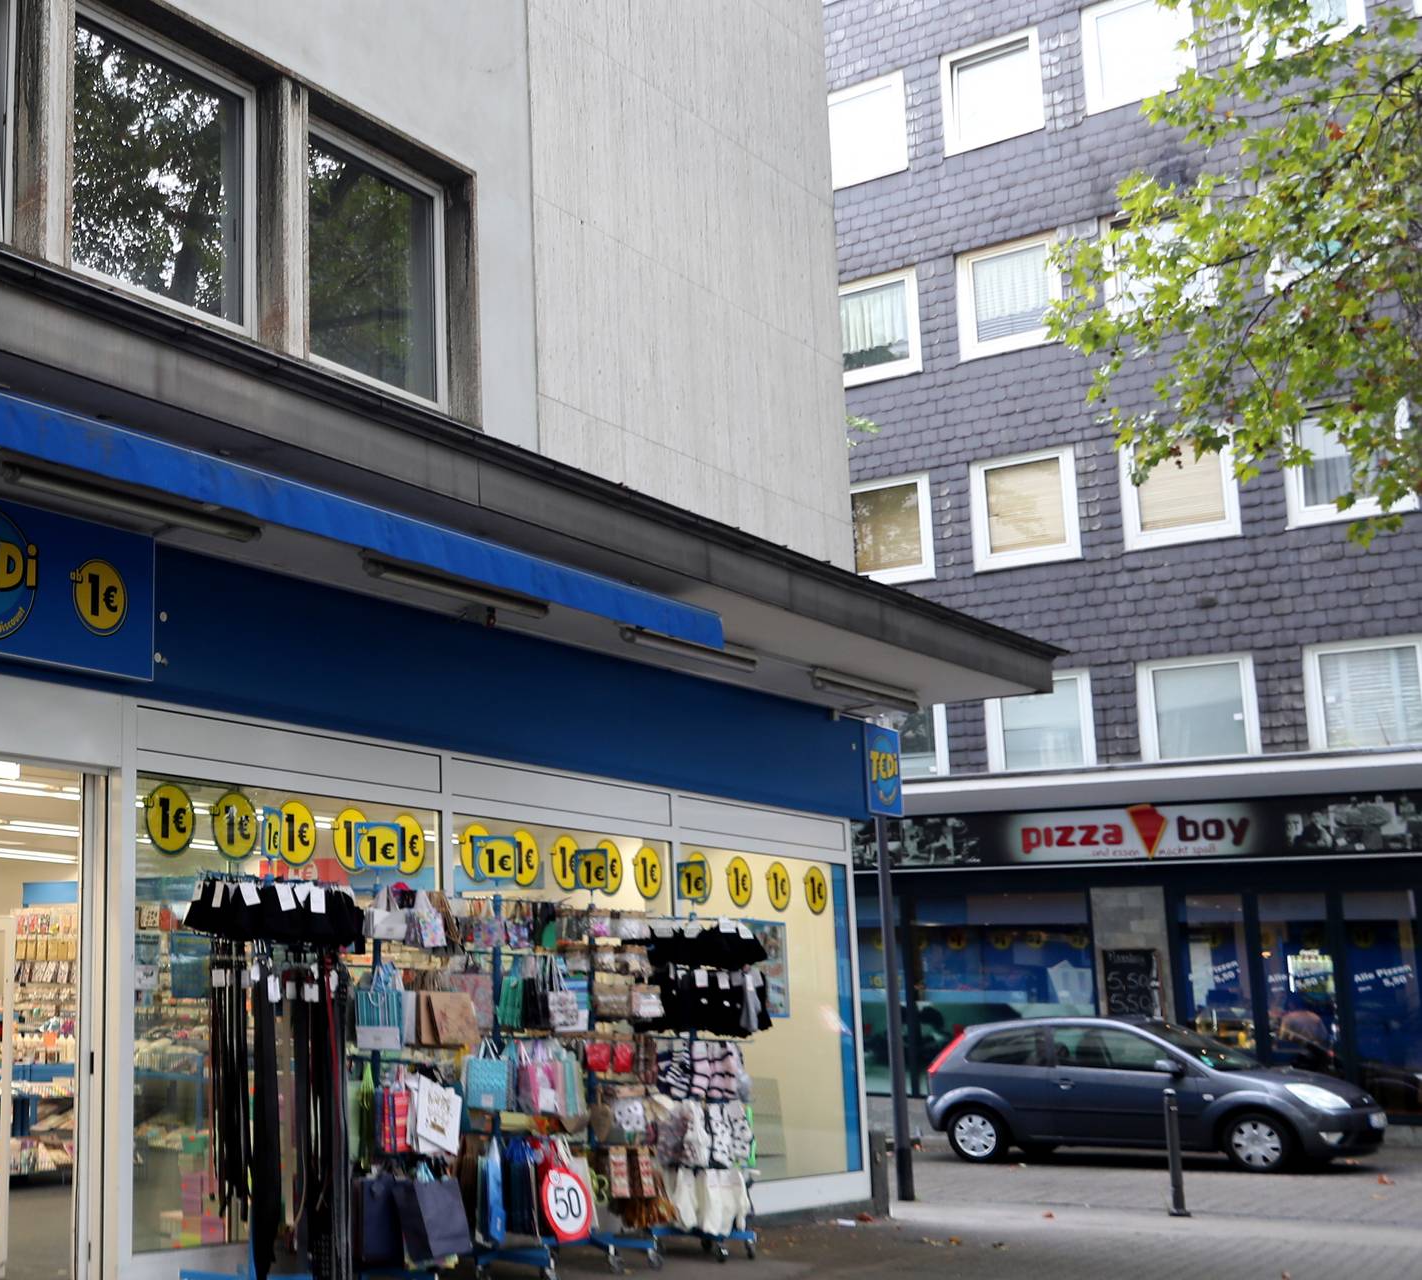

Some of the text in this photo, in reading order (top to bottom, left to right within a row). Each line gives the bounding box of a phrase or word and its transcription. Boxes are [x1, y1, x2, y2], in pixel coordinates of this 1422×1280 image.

[89, 573, 118, 617] 1€
[159, 797, 187, 839] 1€
[225, 805, 251, 846] 1€
[285, 813, 310, 852] 1€
[367, 836, 396, 862] 1€
[1020, 815, 1251, 855] pizza boy
[486, 849, 512, 874] 1€
[585, 861, 605, 884] 1€
[641, 857, 658, 888] 1€
[733, 867, 749, 897] 1€
[772, 871, 787, 901] 1€
[809, 876, 824, 905] 1€
[553, 1186, 582, 1220] 50
